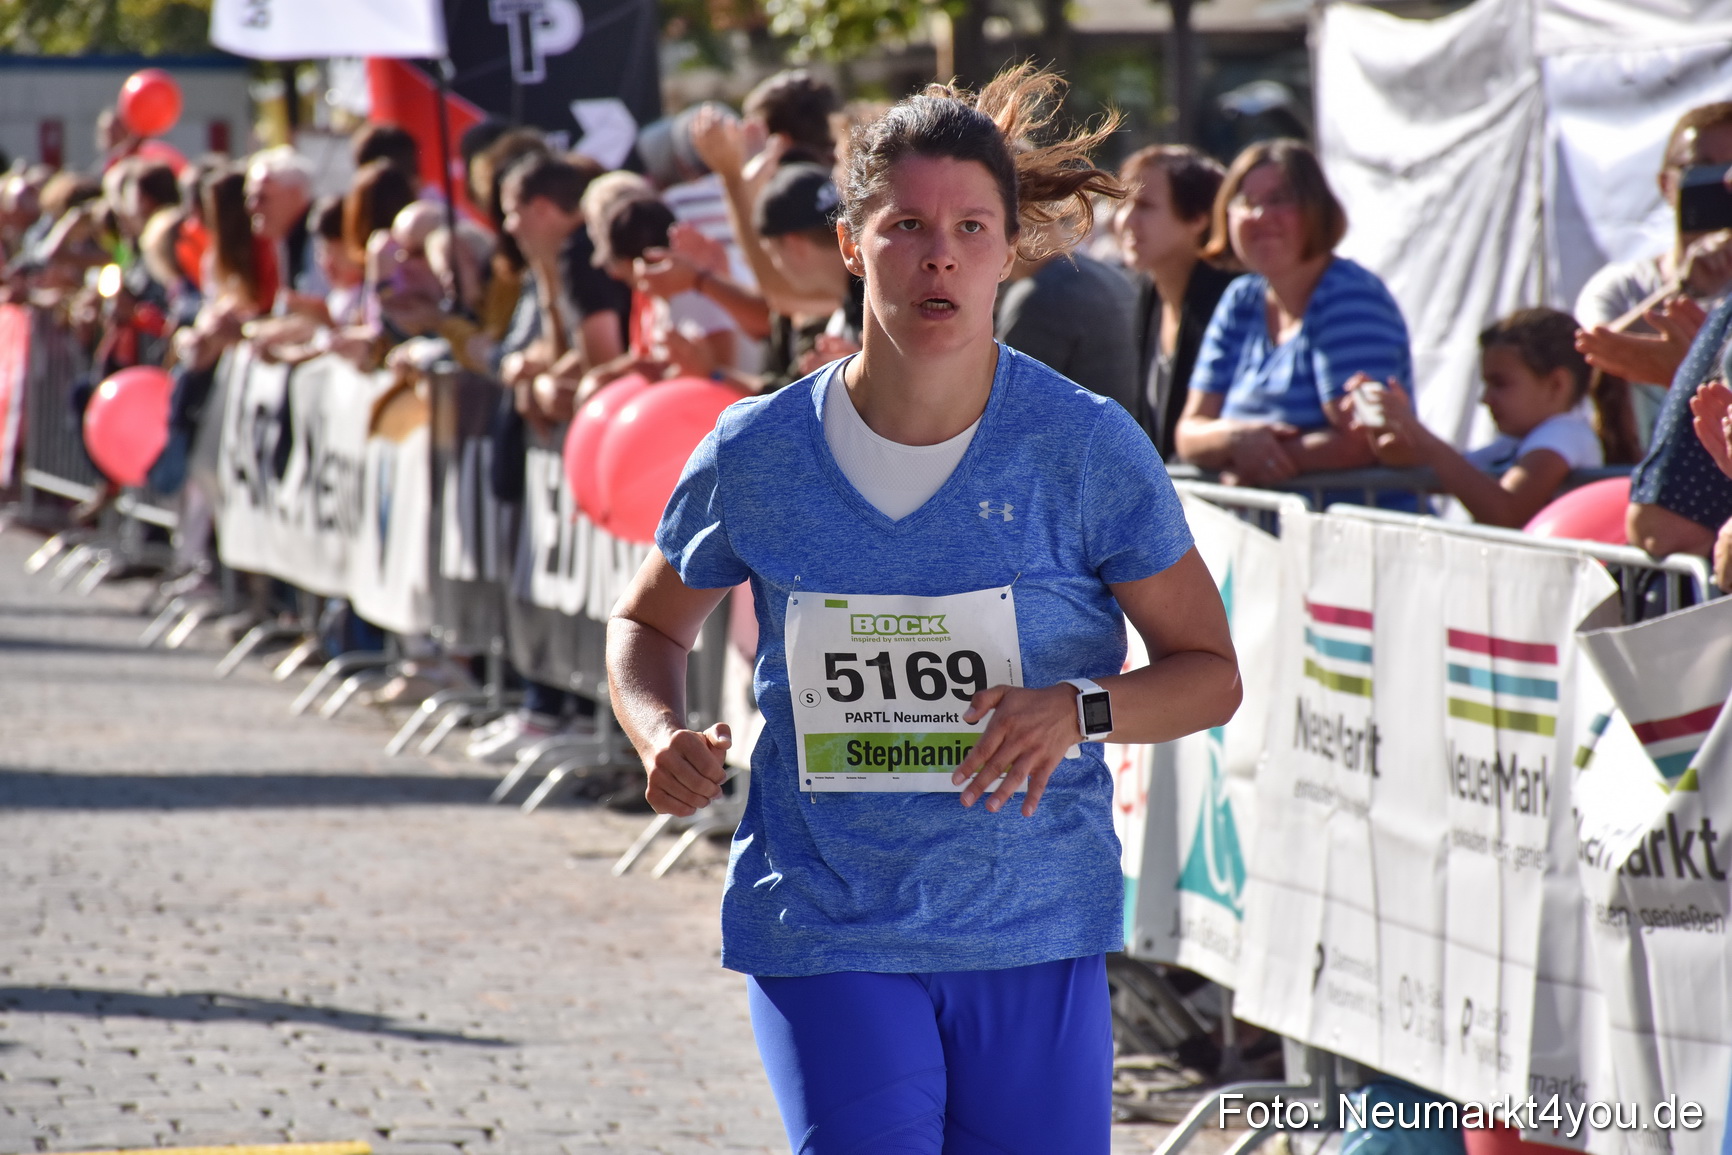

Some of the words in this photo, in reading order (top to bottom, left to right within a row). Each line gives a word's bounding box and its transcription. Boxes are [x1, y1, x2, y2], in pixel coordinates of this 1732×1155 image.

[850, 614, 949, 635] BOCK
[917, 635, 951, 643] concepts
[824, 650, 988, 702] 5169
[806, 693, 814, 704] S
[845, 711, 890, 723] PARTL
[893, 711, 959, 723] Neumarkt
[1640, 904, 1725, 934] genießen
